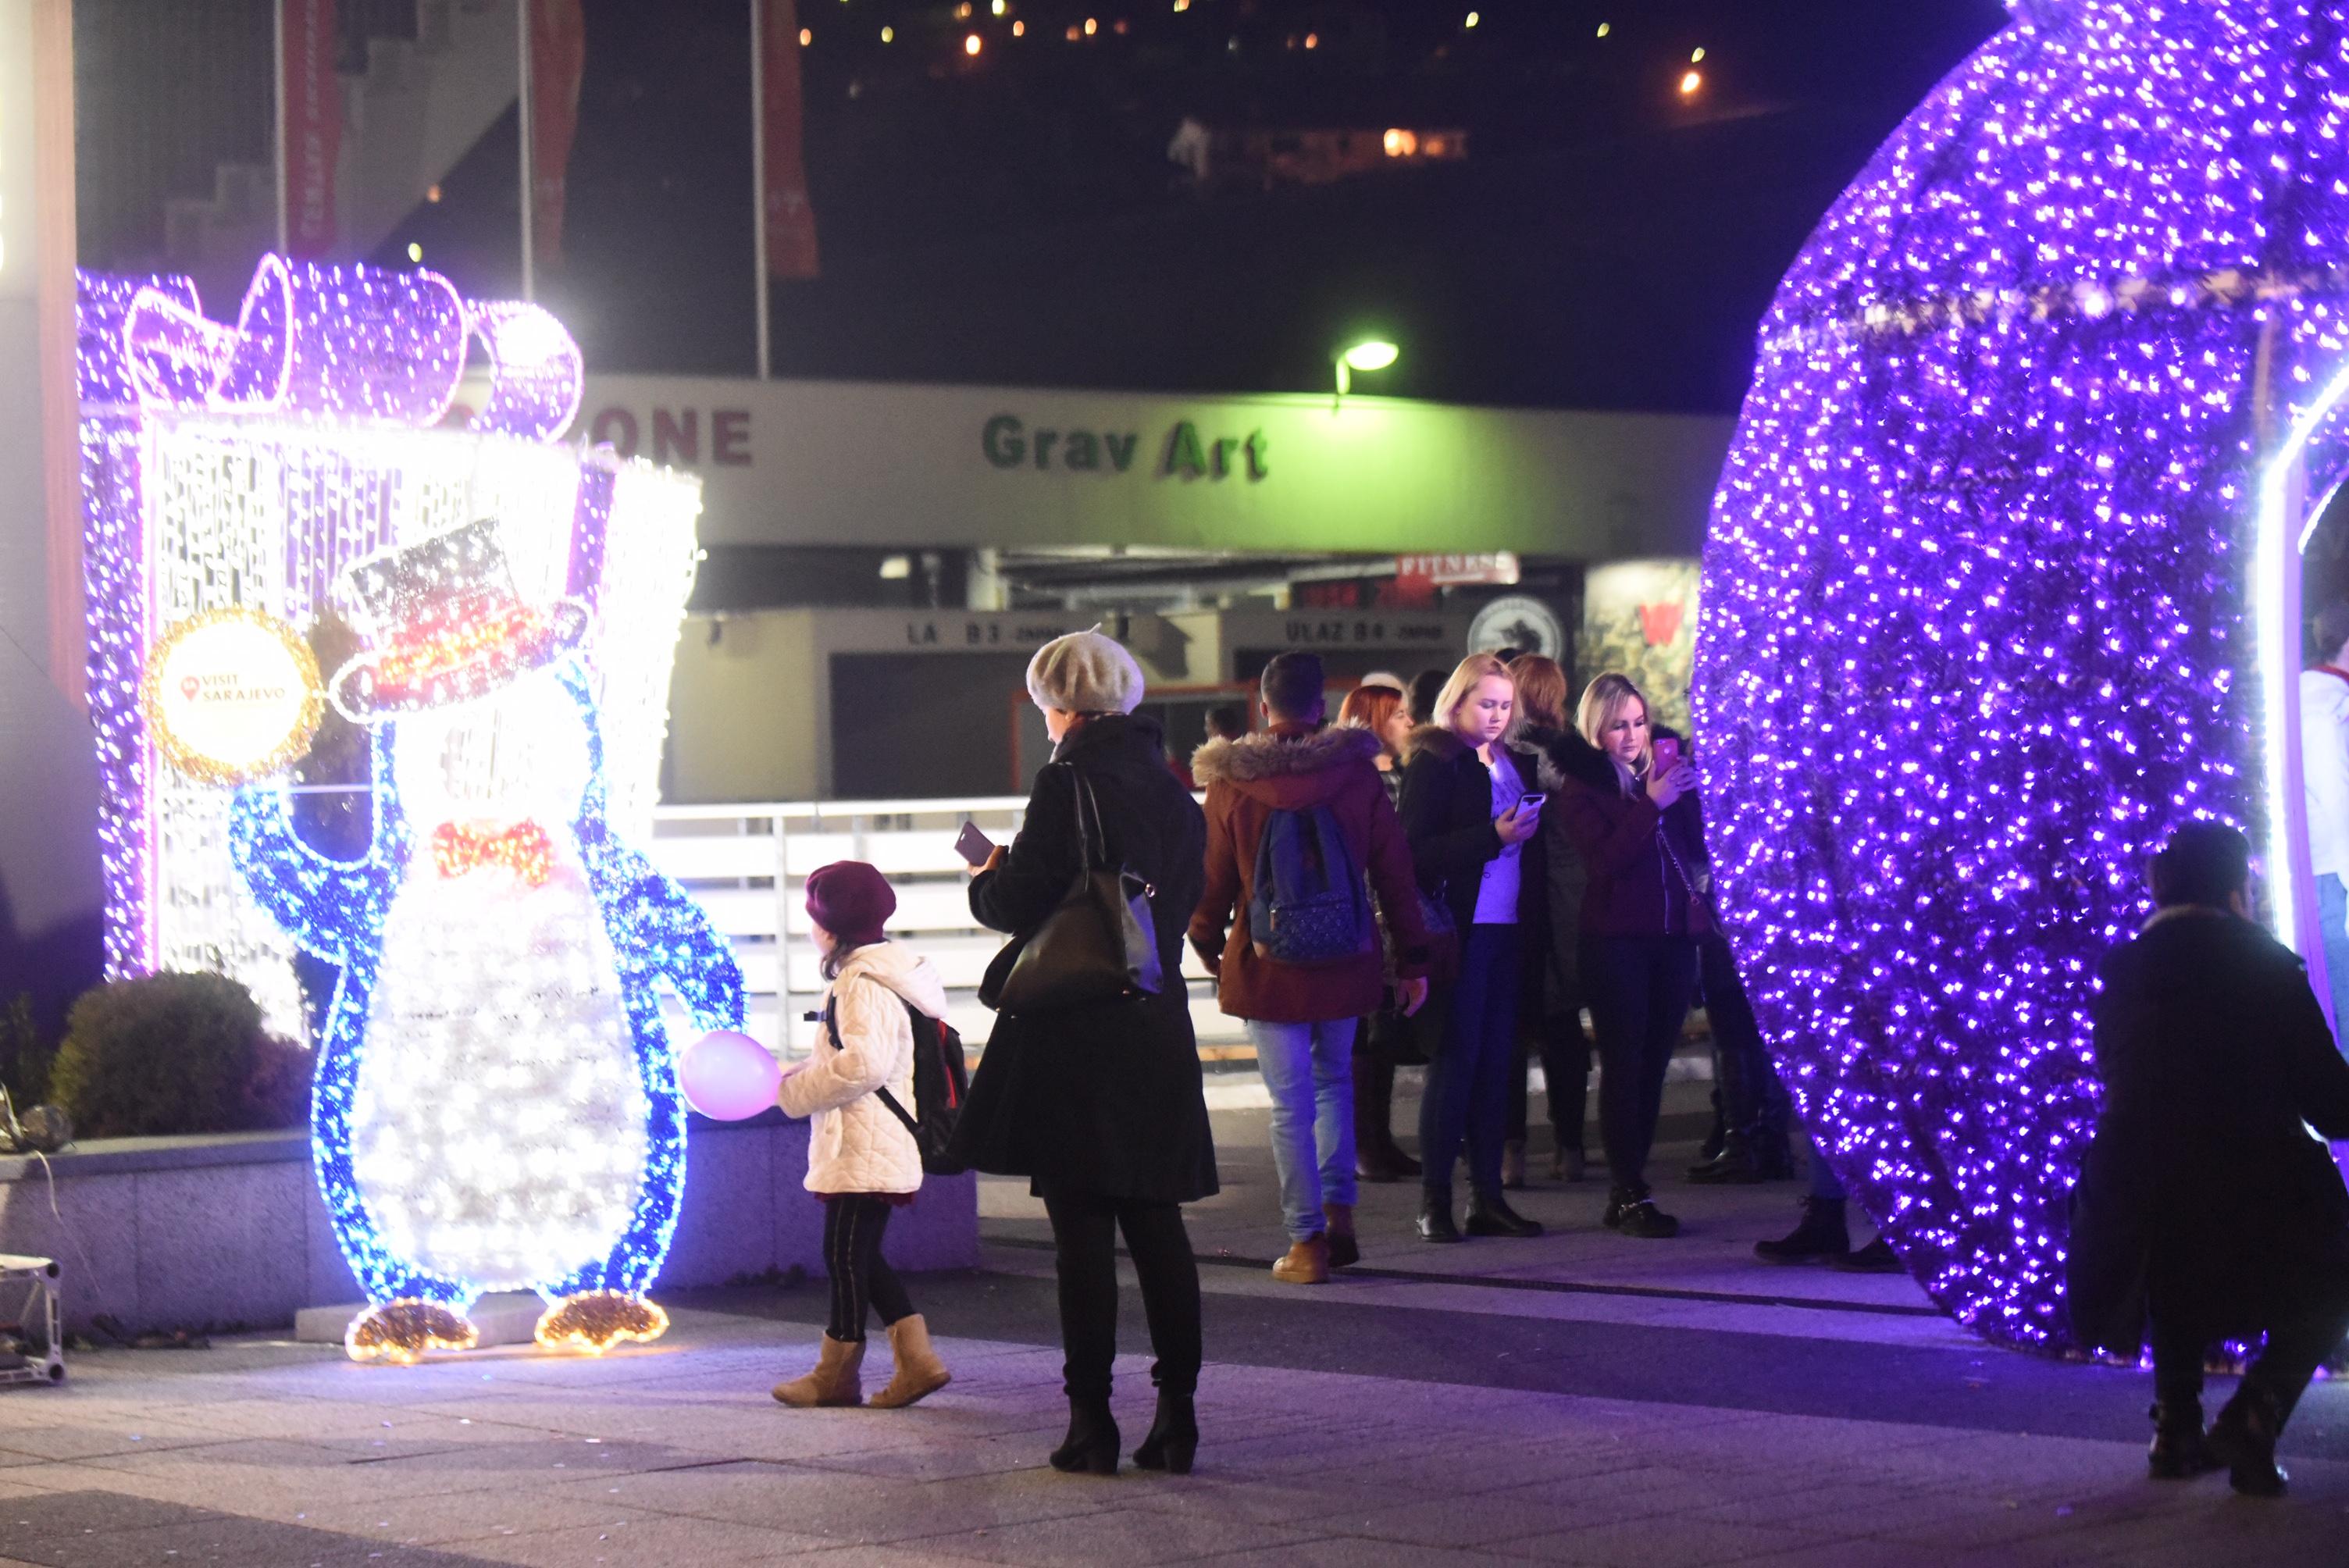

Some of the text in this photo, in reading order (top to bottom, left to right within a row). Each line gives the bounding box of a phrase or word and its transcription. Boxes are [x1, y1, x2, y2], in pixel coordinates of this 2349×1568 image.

[982, 415, 1268, 481] Grav Art
[201, 674, 238, 686] VISIT
[202, 687, 286, 701] SARAJEVO
